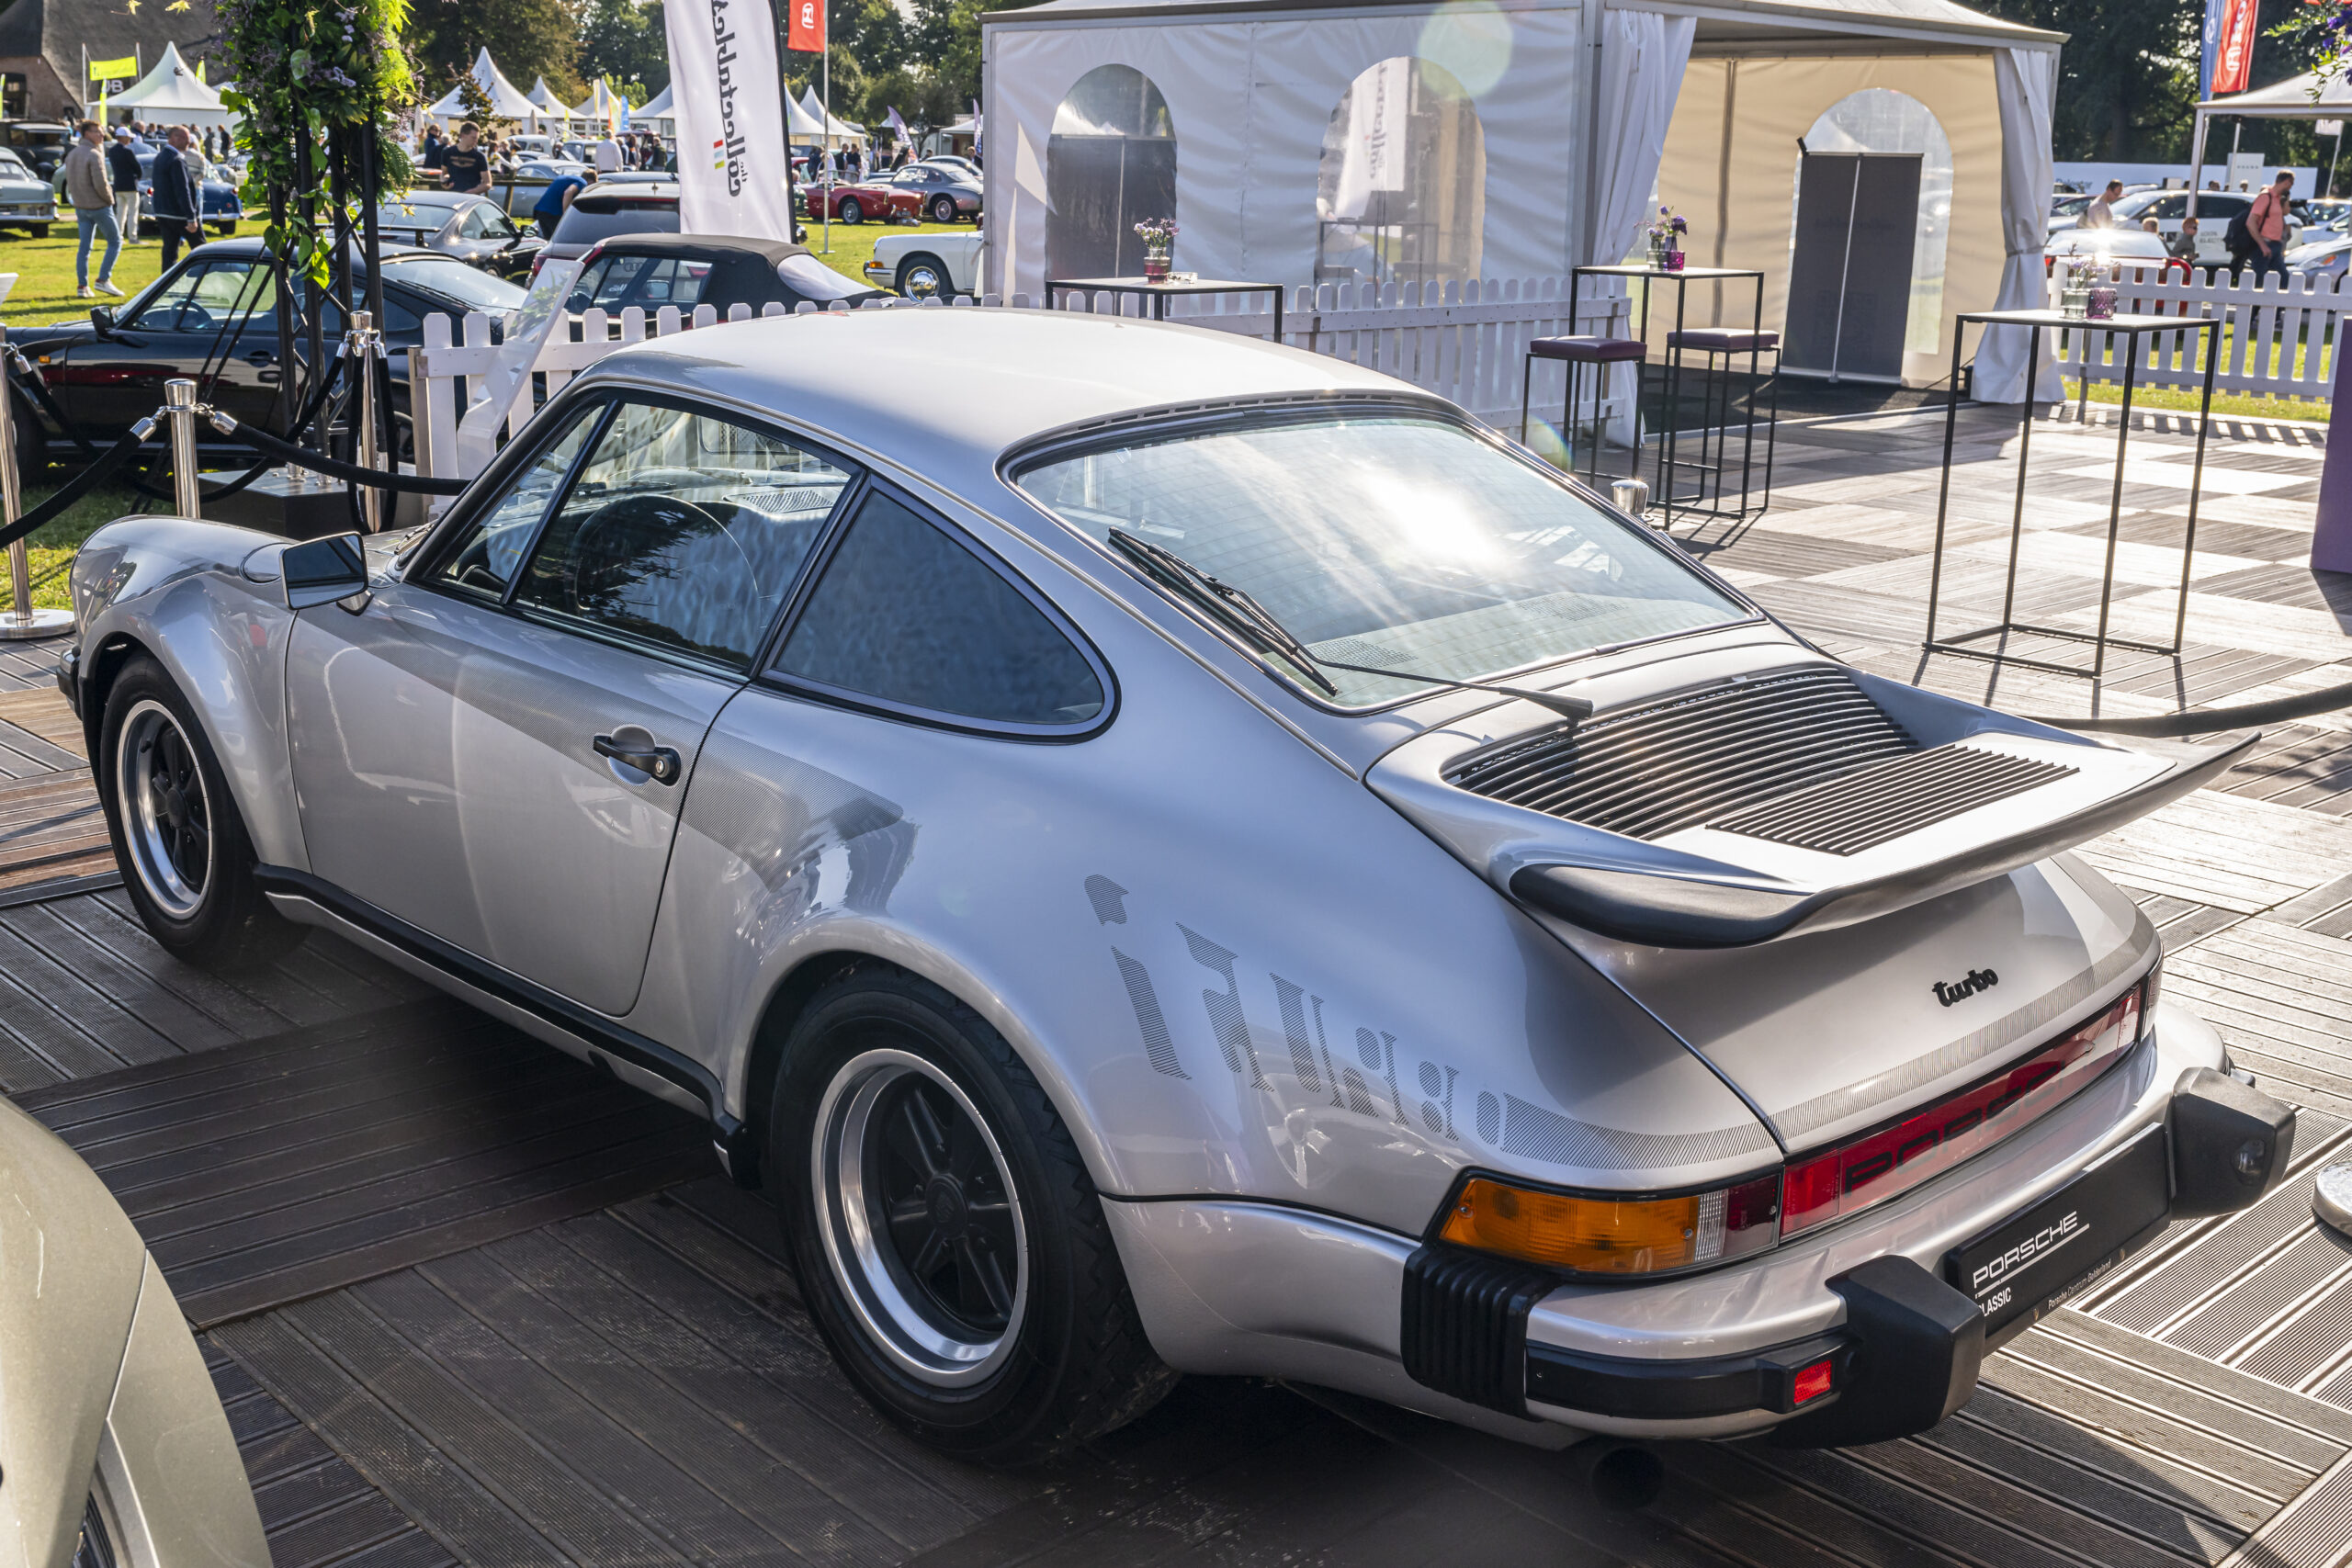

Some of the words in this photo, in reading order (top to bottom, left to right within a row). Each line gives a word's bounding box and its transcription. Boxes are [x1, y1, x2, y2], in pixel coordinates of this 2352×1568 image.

[1932, 966, 1999, 1007] turbo
[1972, 1211, 2078, 1289] PORSCHE
[2048, 1291, 2068, 1311] Porsche
